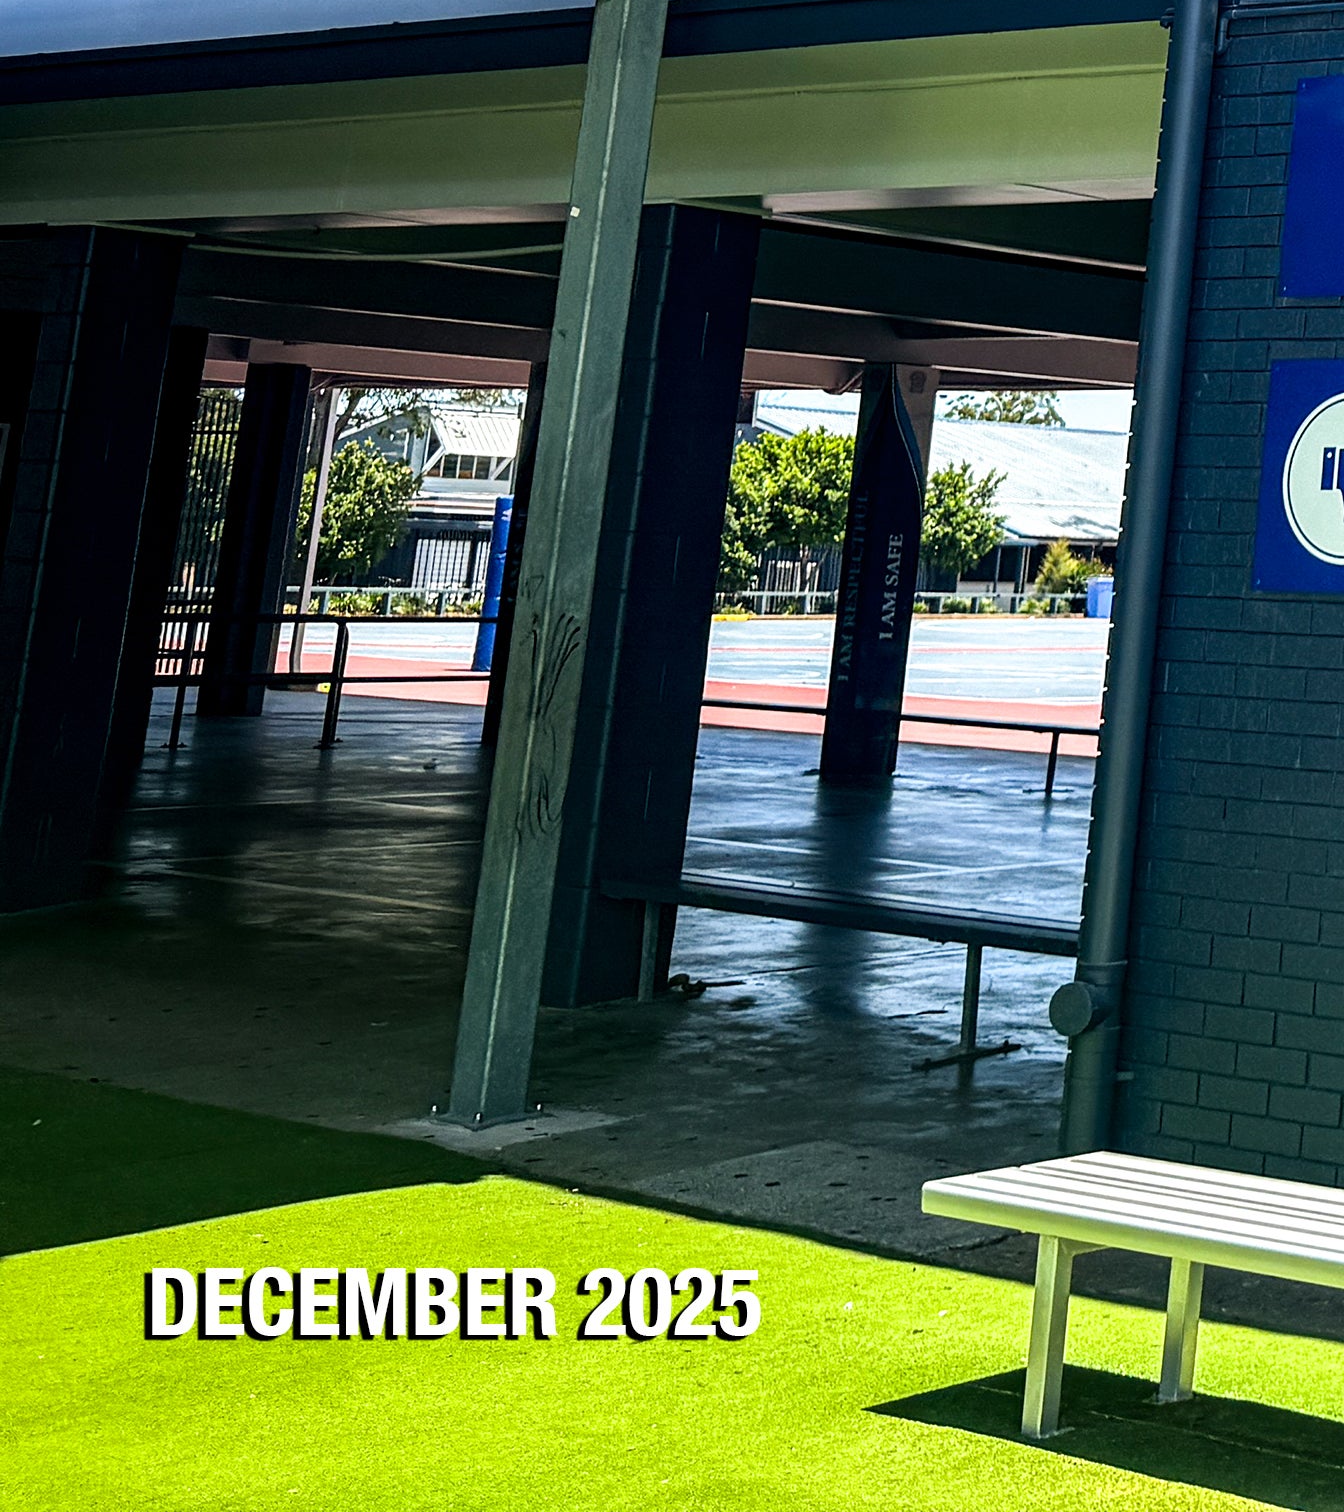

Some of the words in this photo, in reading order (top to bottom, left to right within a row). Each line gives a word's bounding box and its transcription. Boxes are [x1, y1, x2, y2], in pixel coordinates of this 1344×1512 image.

[884, 533, 904, 588] SAFE
[879, 591, 897, 628] AM
[878, 631, 894, 640] I
